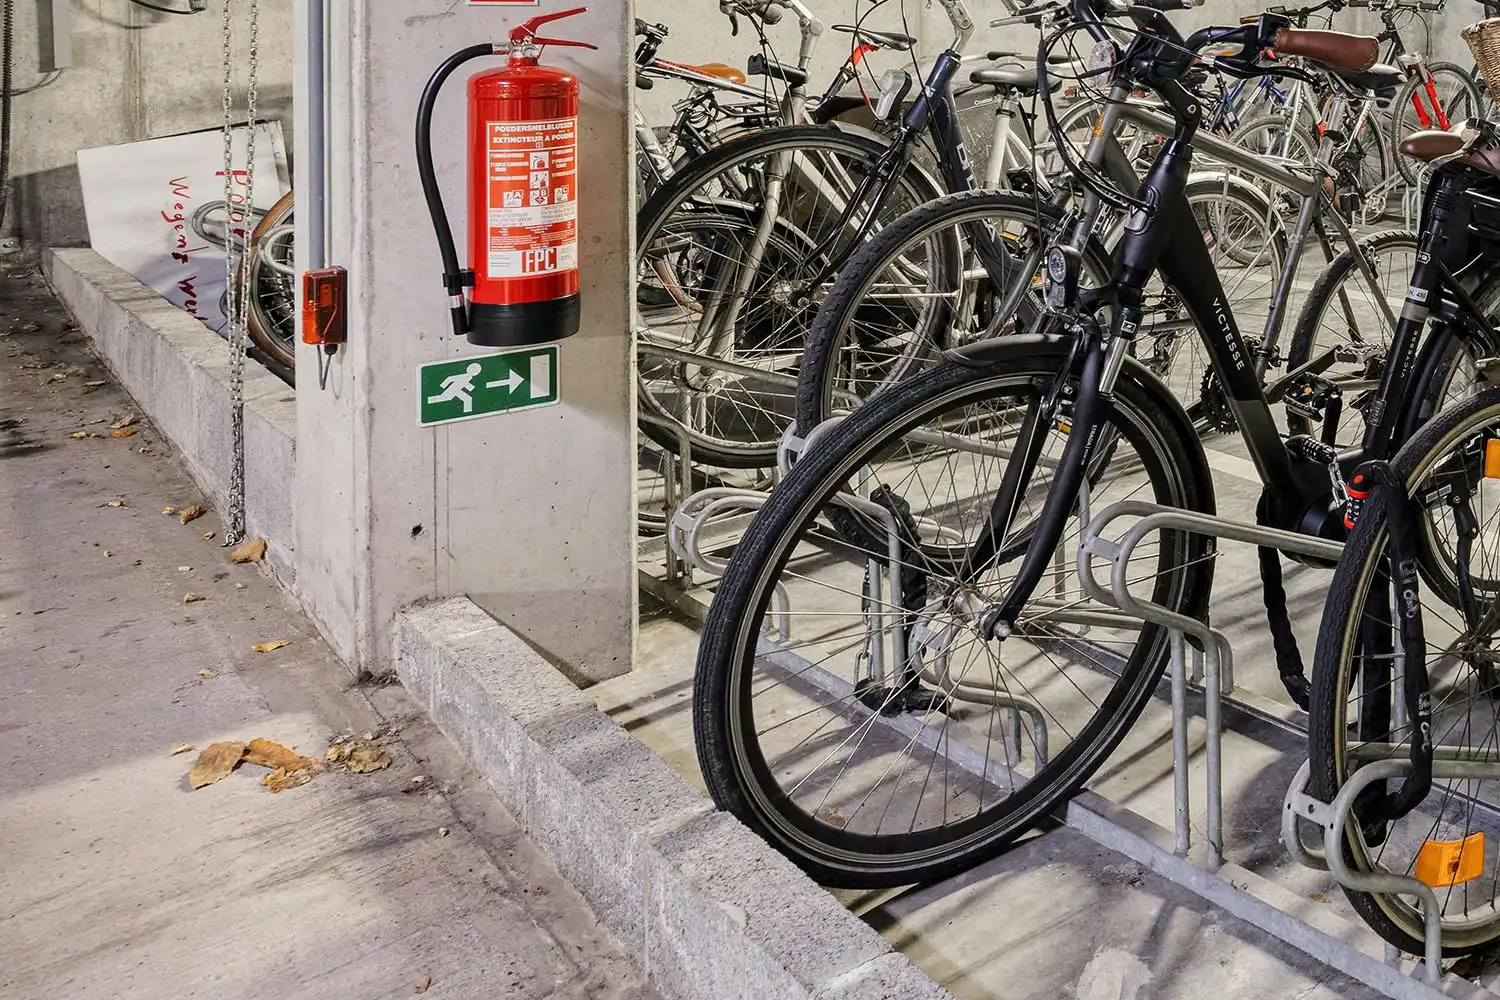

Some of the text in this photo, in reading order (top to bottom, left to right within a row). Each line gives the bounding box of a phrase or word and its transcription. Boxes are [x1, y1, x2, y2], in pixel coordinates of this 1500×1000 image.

[493, 135, 544, 143] EXTINCTEUR
[526, 249, 555, 273] FPC
[1212, 297, 1245, 371] VICTESSE
[1400, 330, 1419, 378] VICTESSE
